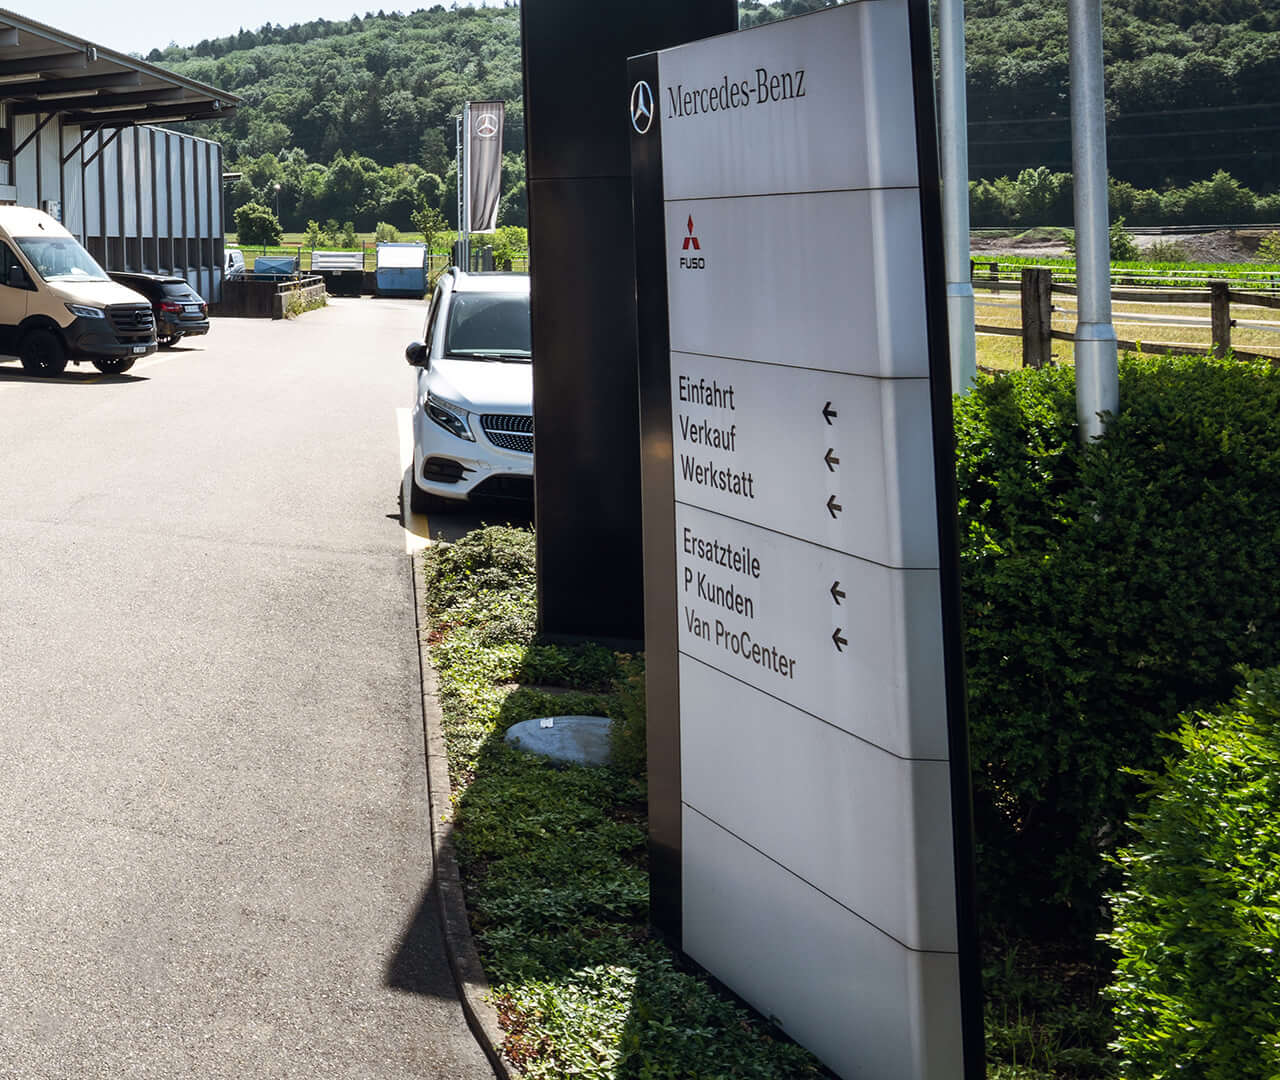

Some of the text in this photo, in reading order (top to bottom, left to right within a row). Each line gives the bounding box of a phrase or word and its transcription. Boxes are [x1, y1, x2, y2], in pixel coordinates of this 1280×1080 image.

[668, 68, 806, 118] Mercedes-Benz
[679, 258, 705, 269] FUSO
[679, 375, 735, 410] Einfahrt
[679, 414, 736, 452] Verkauf
[681, 454, 754, 499] Werkstatt
[683, 527, 761, 579] Ersatzteile
[684, 566, 754, 619] P Kunden
[684, 606, 796, 679] Van ProCenter
